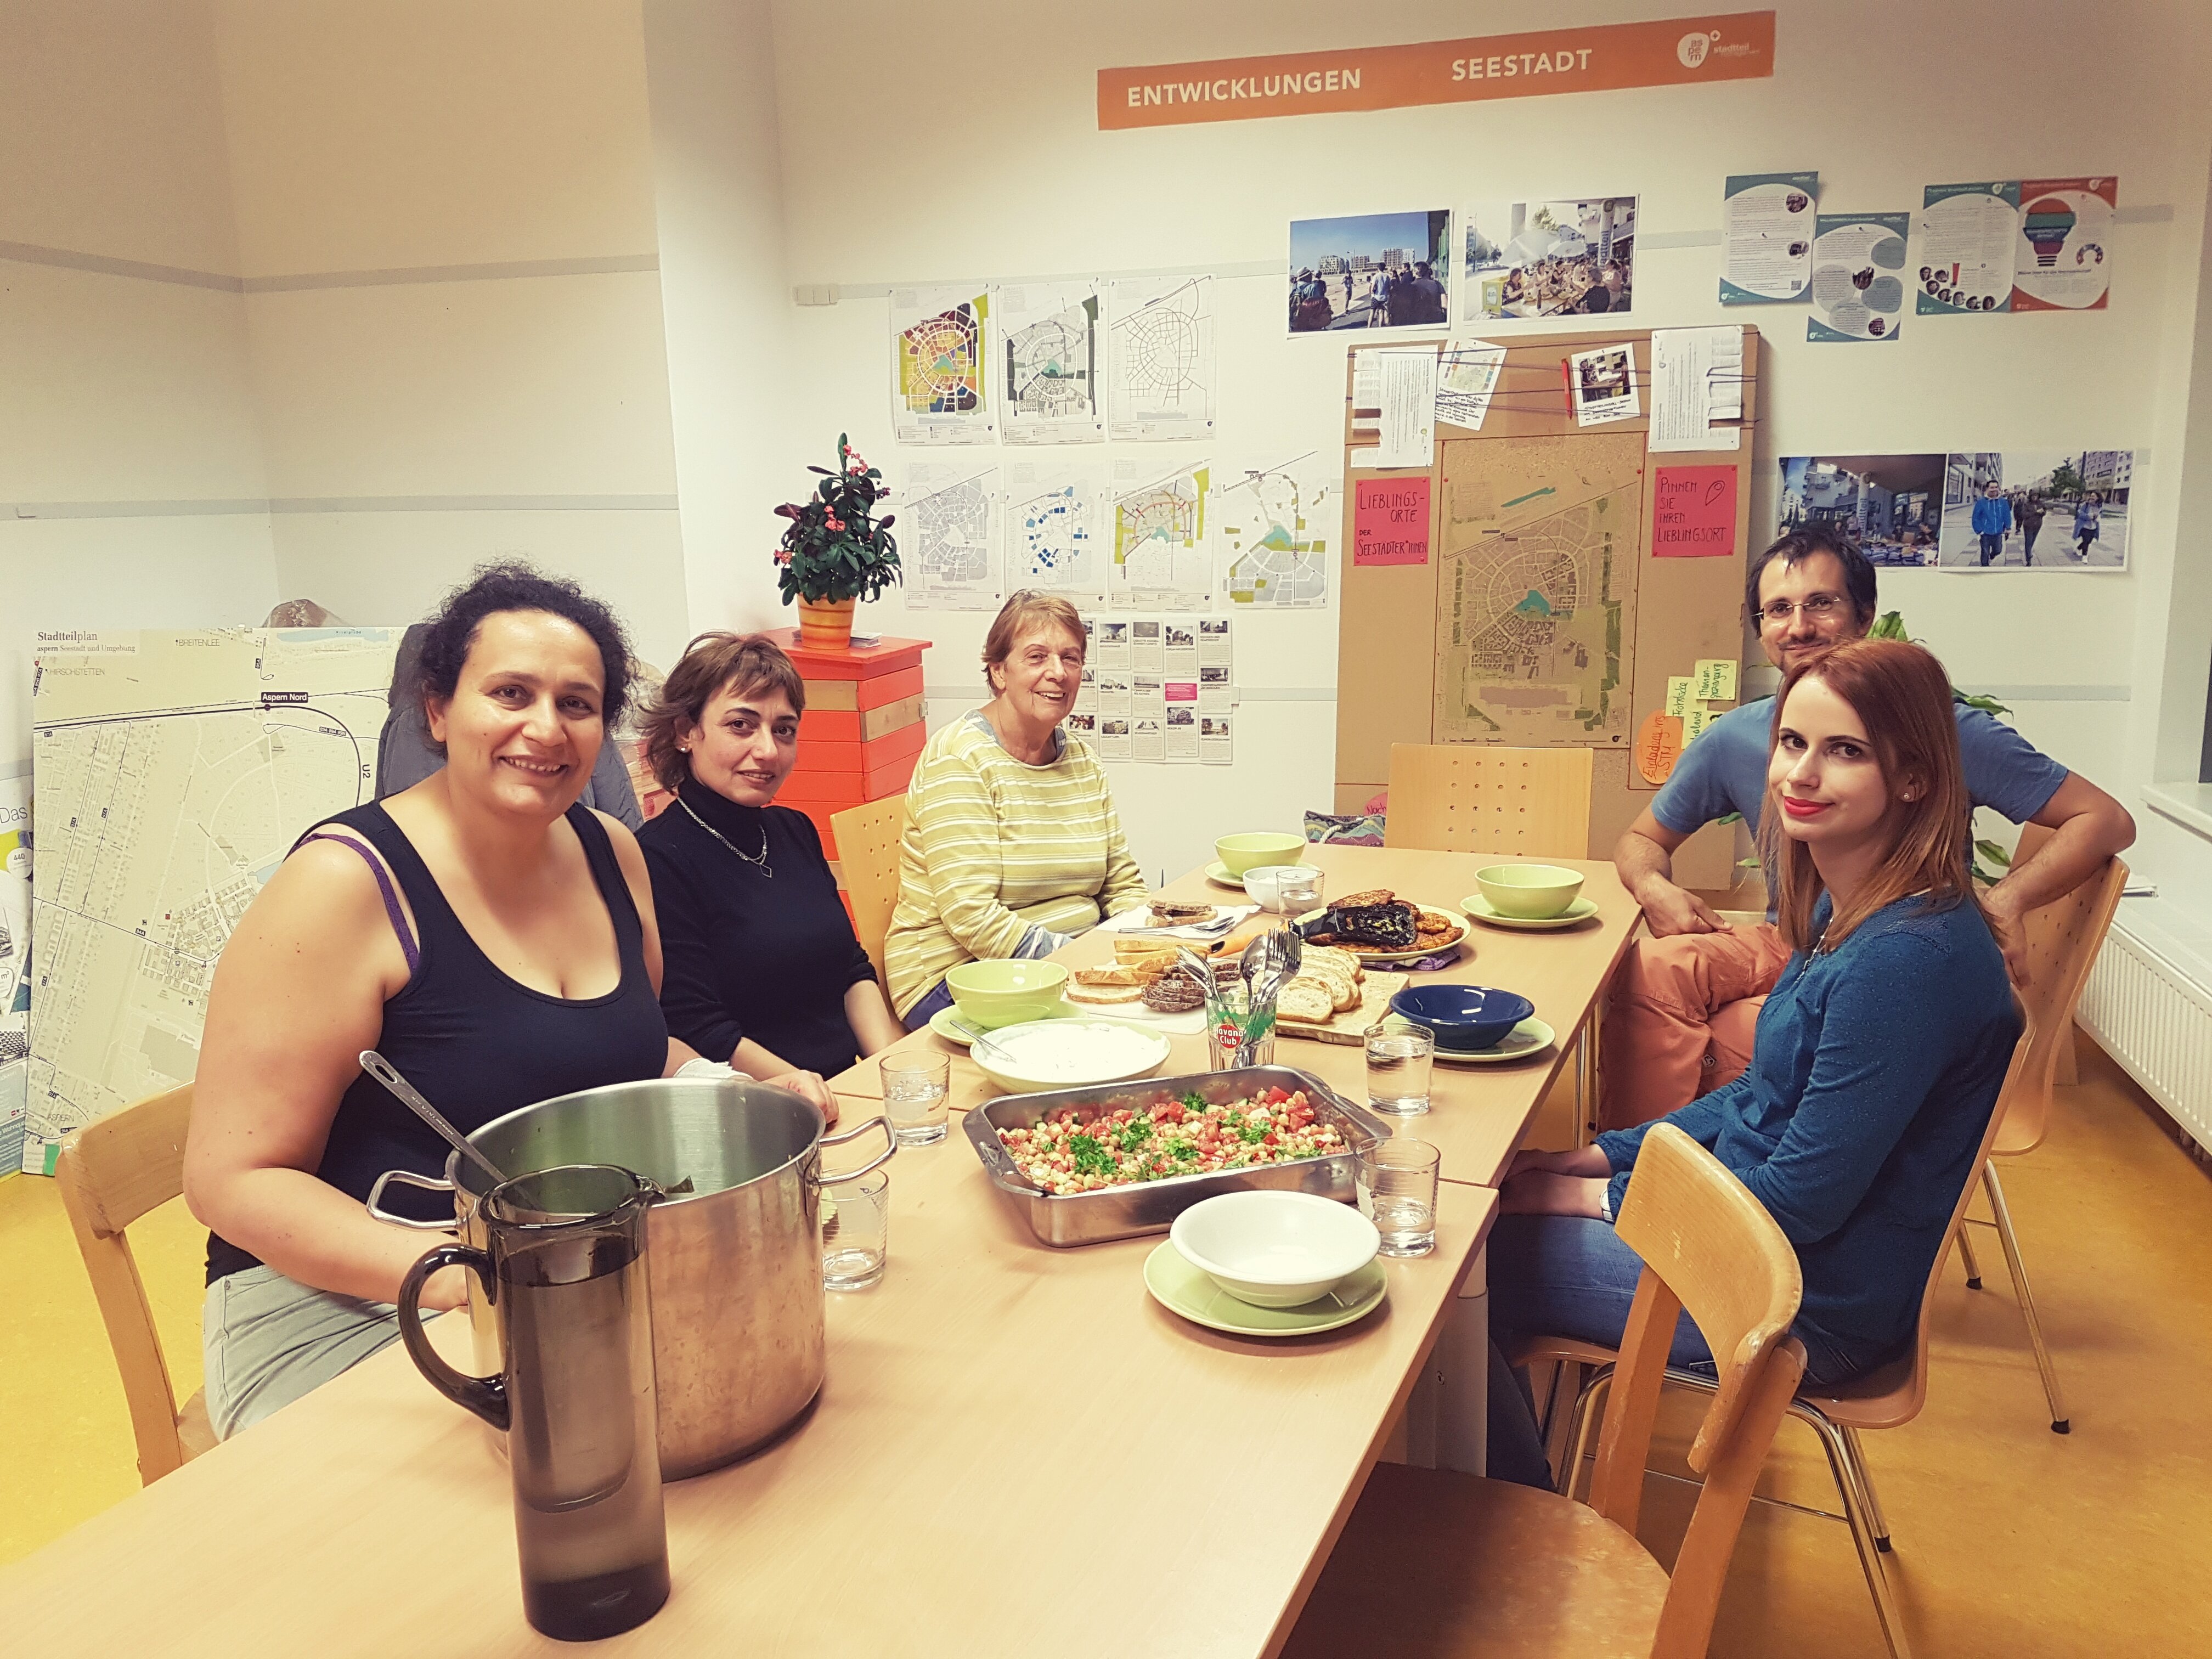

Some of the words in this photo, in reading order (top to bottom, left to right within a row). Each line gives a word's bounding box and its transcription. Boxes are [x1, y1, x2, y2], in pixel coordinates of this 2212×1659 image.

[1127, 68, 1361, 107] ENTWICKLUNGEN
[1451, 49, 1592, 81] SEESTADT
[1661, 477, 1697, 493] PINNEN
[1360, 489, 1425, 510] LIEBLINGS-
[1659, 498, 1676, 509] SIE
[1390, 510, 1418, 523] ORTE
[1659, 512, 1685, 523] IHREN
[1657, 527, 1726, 542] LIEBLINGSORT
[37, 631, 98, 643] Stadtteilplan
[101, 645, 136, 653] Umgebung
[262, 693, 288, 702] Aspern
[362, 764, 370, 779] U2
[0, 807, 28, 823] Das
[1220, 1035, 1237, 1045] Club
[48, 1113, 75, 1122] ASPERN
